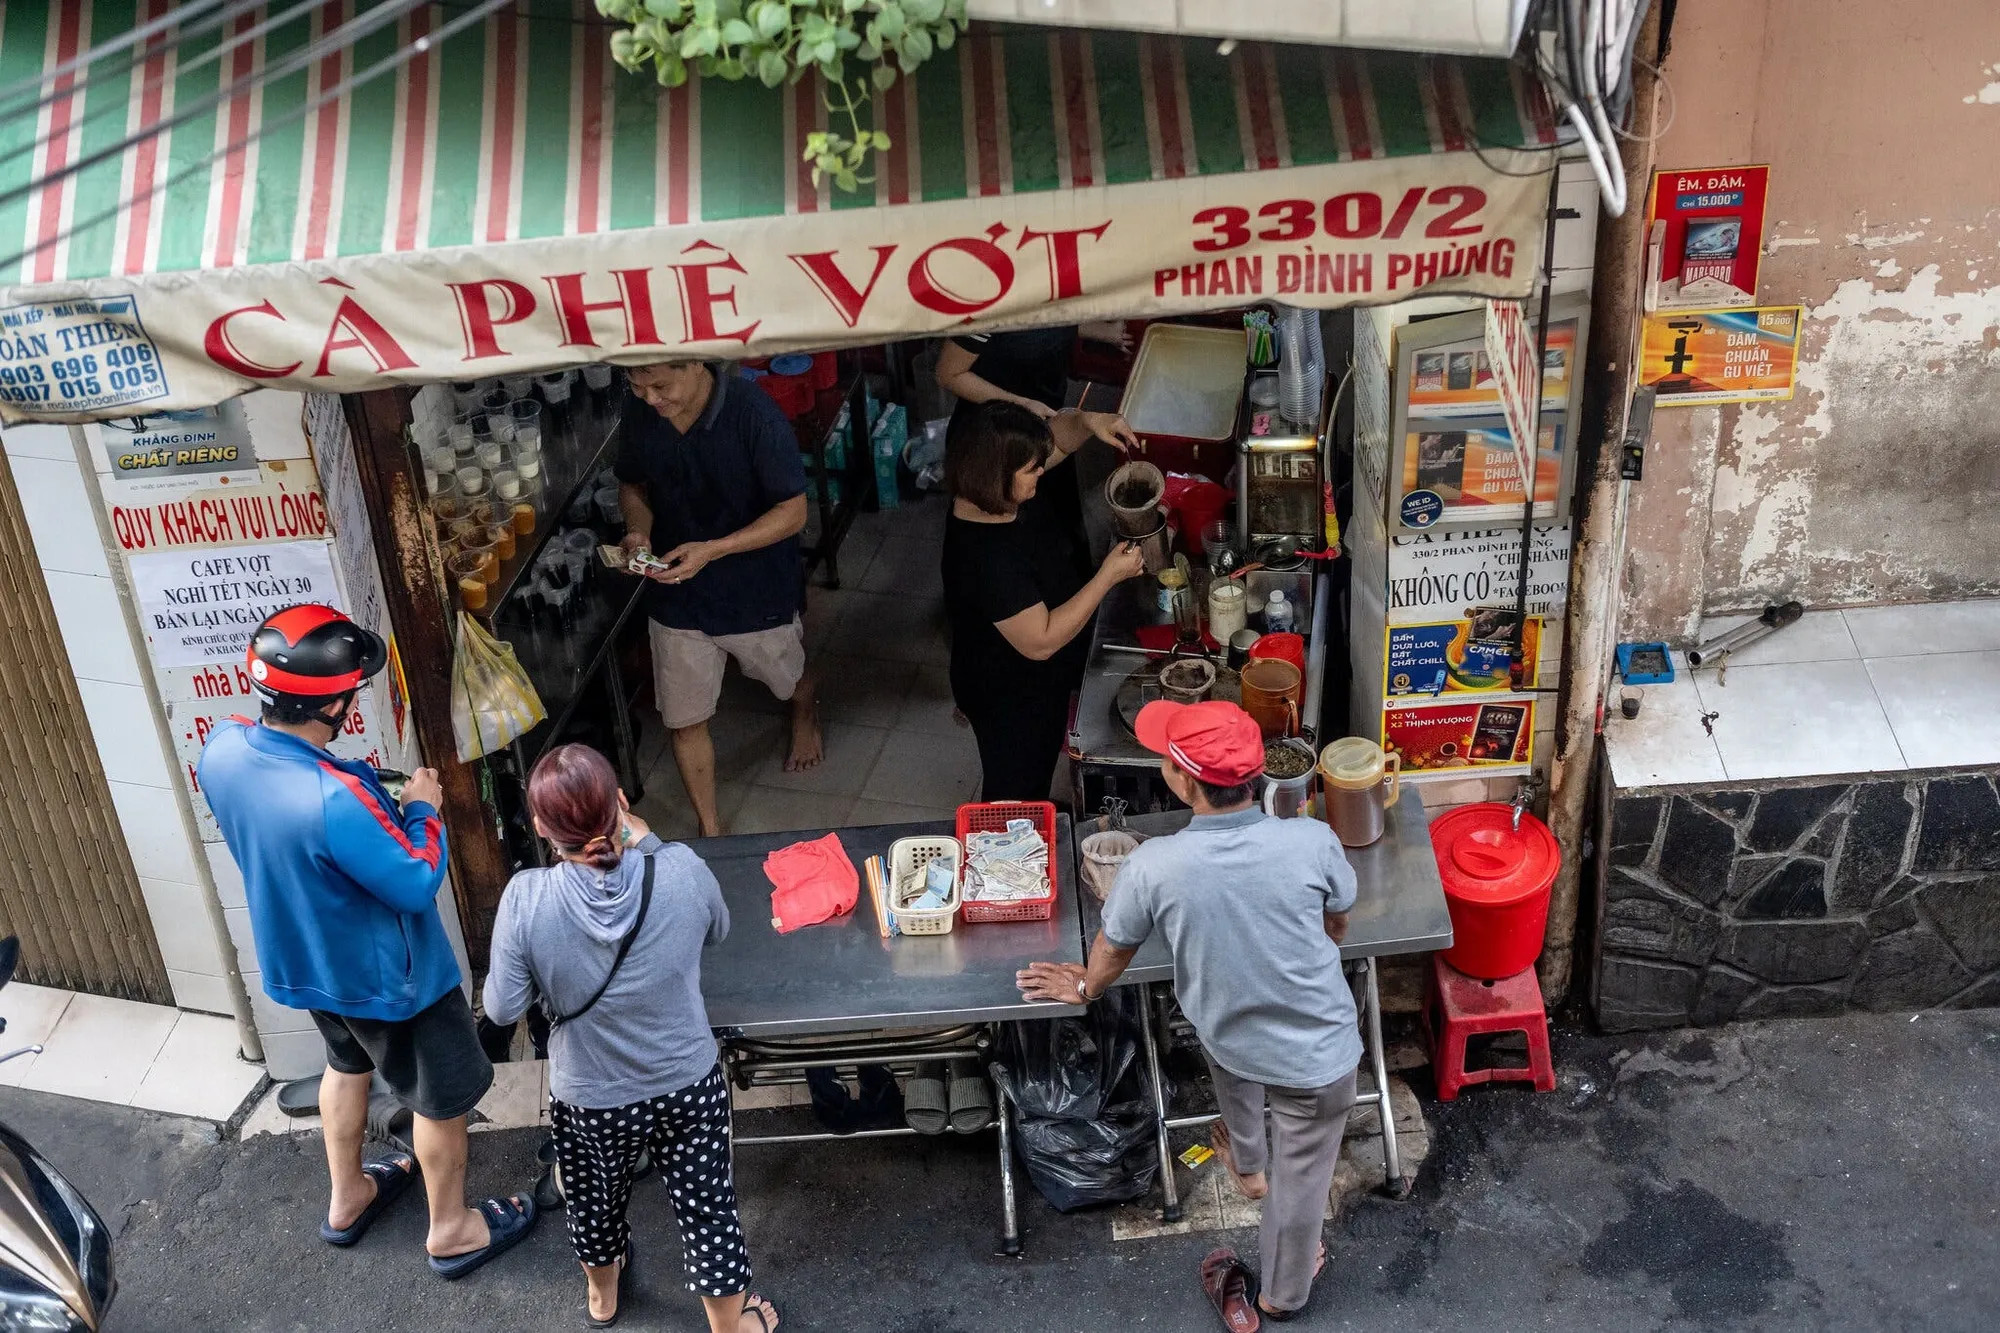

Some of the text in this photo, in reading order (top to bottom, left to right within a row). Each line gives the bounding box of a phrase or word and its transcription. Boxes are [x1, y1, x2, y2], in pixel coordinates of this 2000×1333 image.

[1677, 174, 1746, 191] ÊM. ĐẬM.
[1192, 185, 1487, 252] 330/2
[1154, 237, 1516, 297] PHAN ĐÌNH PHÙNG
[1685, 265, 1732, 285] MARLBORO
[204, 219, 1113, 379] CÀ PHÊ VỢT
[56, 317, 141, 352] THIỆN
[1727, 331, 1759, 349] ĐẬM.
[0, 343, 153, 386] 903 696 406
[1723, 361, 1773, 379] GU VIỆT
[59, 376, 101, 399] 015
[109, 363, 158, 390] 005
[117, 444, 239, 471] CHẤT RIÊNG
[1483, 481, 1500, 494] GU
[230, 496, 270, 540] VUI
[268, 482, 326, 537] LÒNG
[1407, 499, 1421, 508] WE
[1412, 549, 1439, 560] 330/2
[1442, 546, 1475, 557] PHAN
[1478, 541, 1508, 553] ĐÌNH
[191, 554, 271, 578] CAFE VỢT
[163, 575, 312, 606] NGHỈ TẾT NGÀY 30
[1390, 561, 1490, 608] KHÔNG CÓ
[154, 609, 190, 630] BÁN
[191, 610, 221, 630] LẠI
[221, 602, 268, 625] NGÀY
[181, 634, 204, 646] KÍNH
[204, 632, 228, 644] CHÚC
[229, 630, 247, 643] QUÝ
[203, 643, 247, 656] AN KHANG
[1469, 645, 1511, 657] CAMEL
[1418, 656, 1445, 666] CHILL
[193, 665, 233, 699] nhà
[1390, 713, 1404, 721] X2
[1390, 721, 1404, 729] X2
[1405, 718, 1436, 729] THỊNH
[1436, 715, 1474, 726] VƯỢNG
